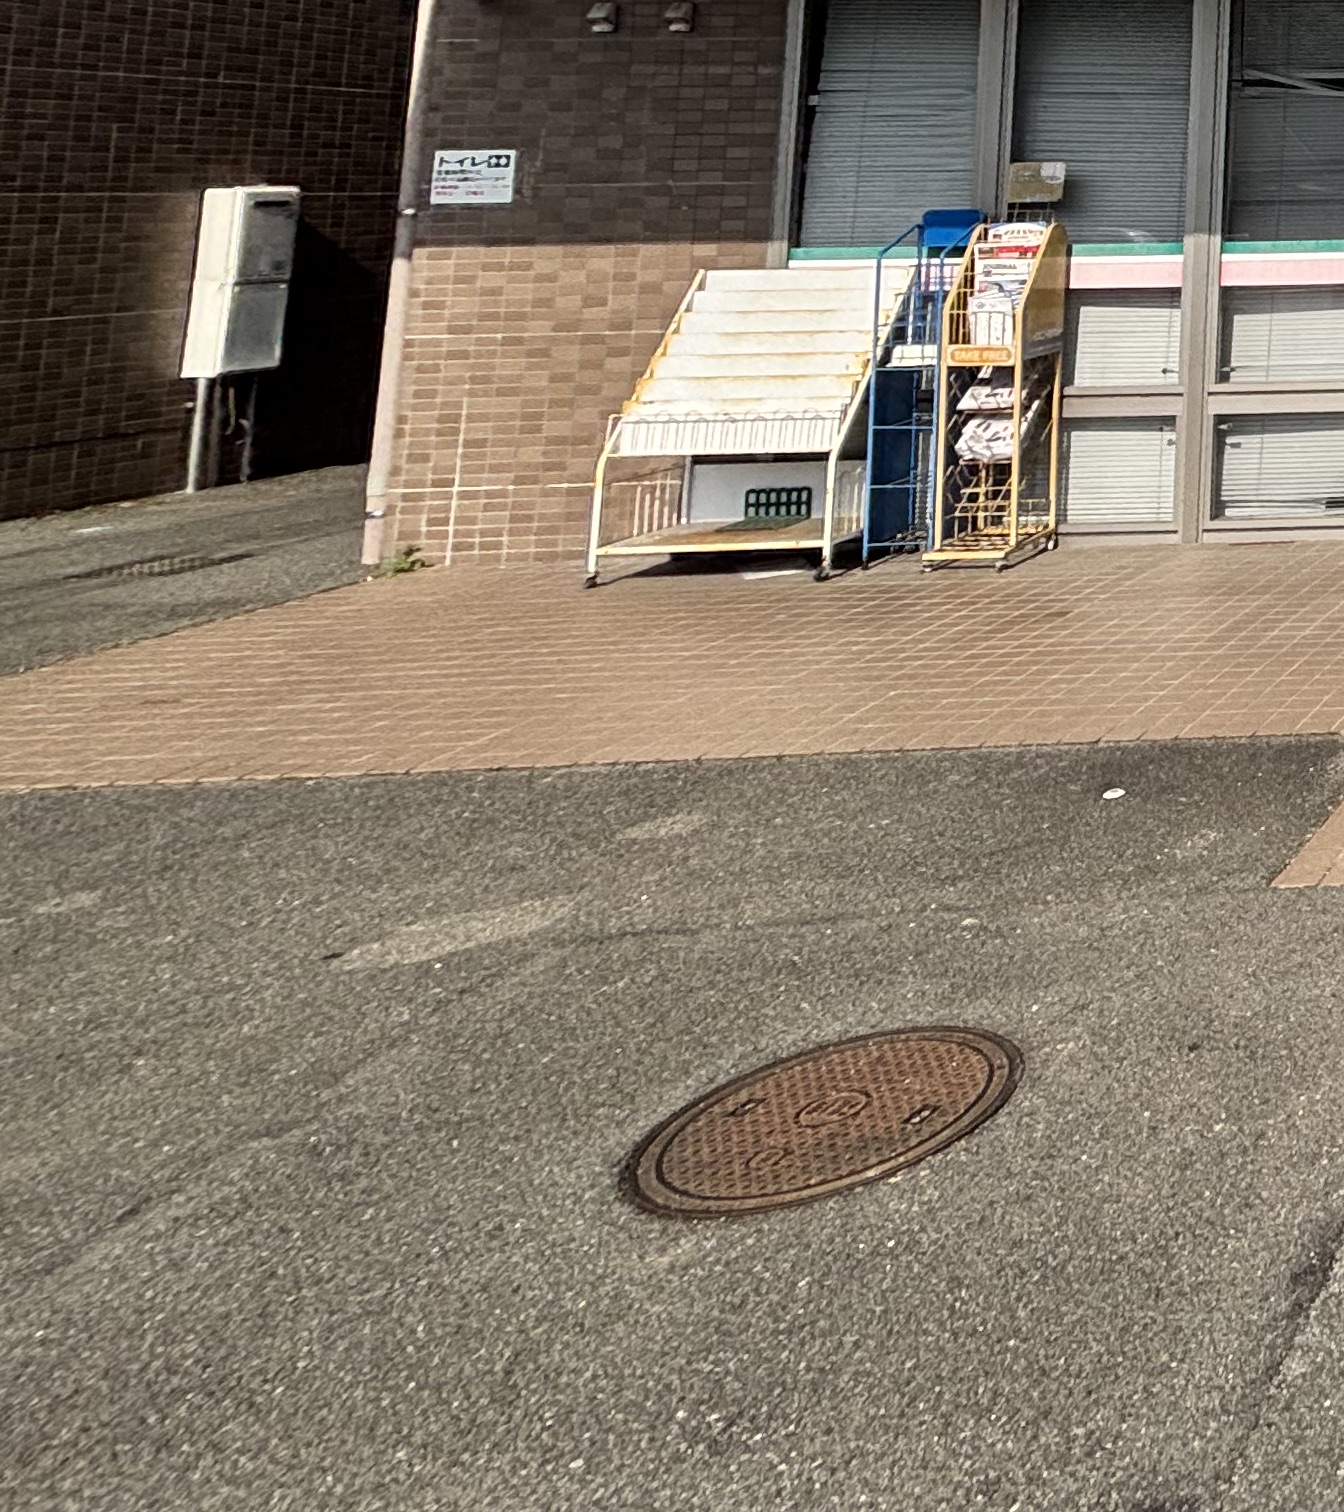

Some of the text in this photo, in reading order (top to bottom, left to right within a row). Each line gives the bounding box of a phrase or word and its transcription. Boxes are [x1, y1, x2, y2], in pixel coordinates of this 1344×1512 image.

[438, 156, 488, 168] トイレ
[954, 350, 1009, 361] TAKE FREE
